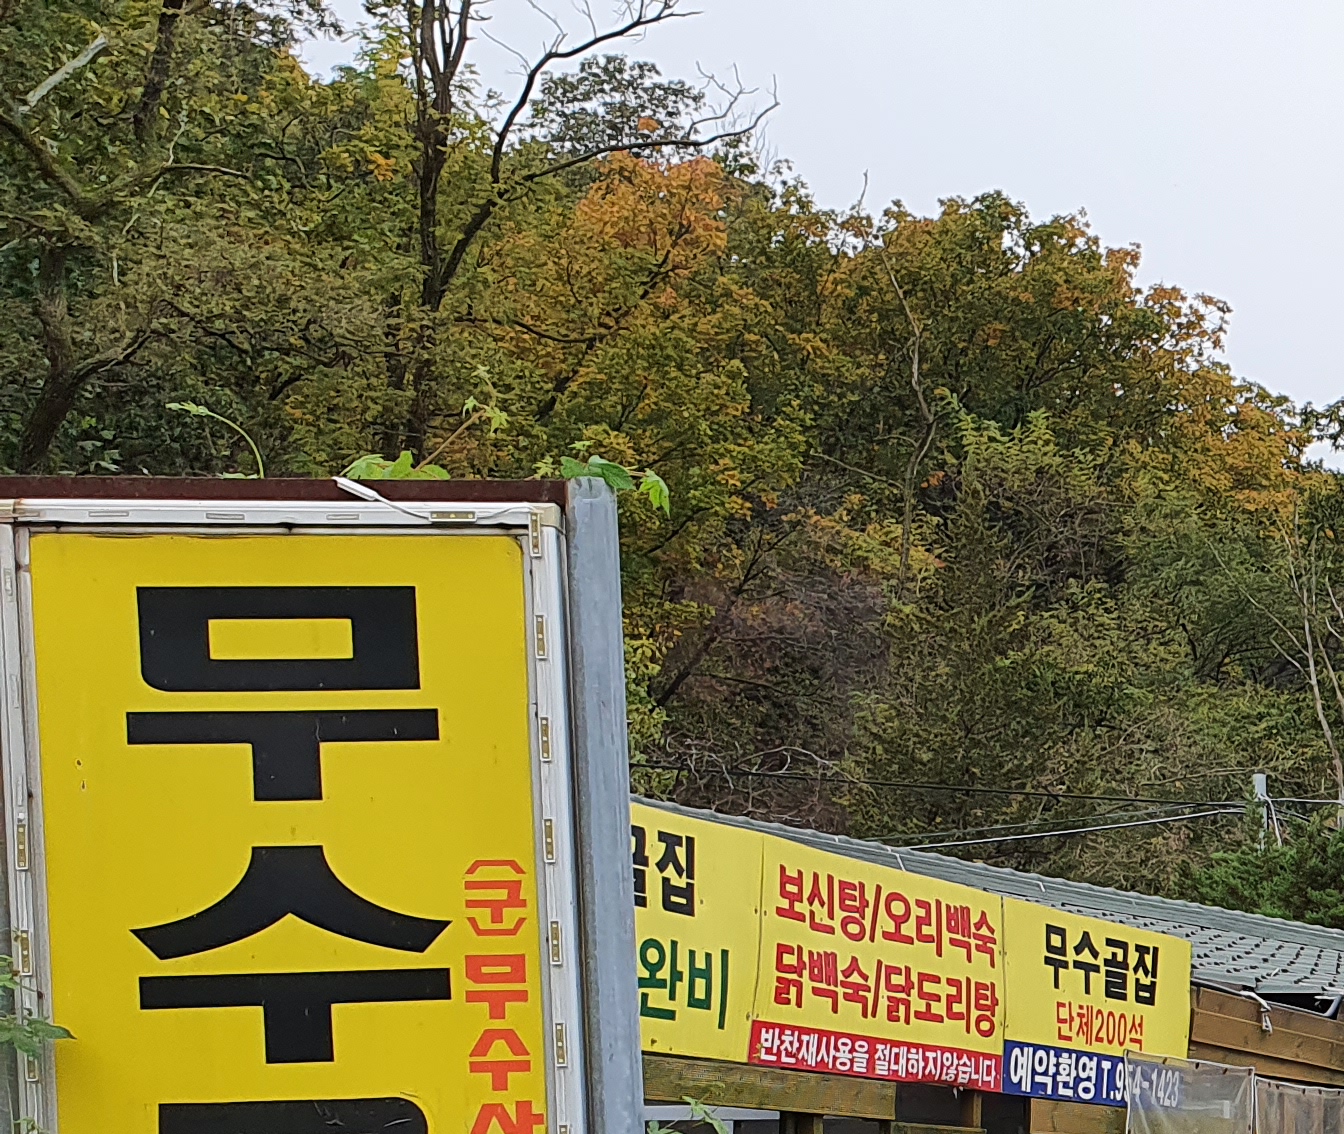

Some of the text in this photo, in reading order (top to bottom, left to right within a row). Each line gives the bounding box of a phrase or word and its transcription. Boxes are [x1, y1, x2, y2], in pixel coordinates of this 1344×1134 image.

[775, 863, 997, 969] 보신탕/오리백숙
[638, 937, 730, 1031] 완비
[773, 942, 999, 1038] 닭백숙/닭도리탕
[1043, 922, 1160, 1007] 무수골집
[760, 1027, 870, 1074] 반찬재사용을
[1056, 1000, 1144, 1052] 단체200석
[1009, 1046, 1099, 1100] 예약환영
